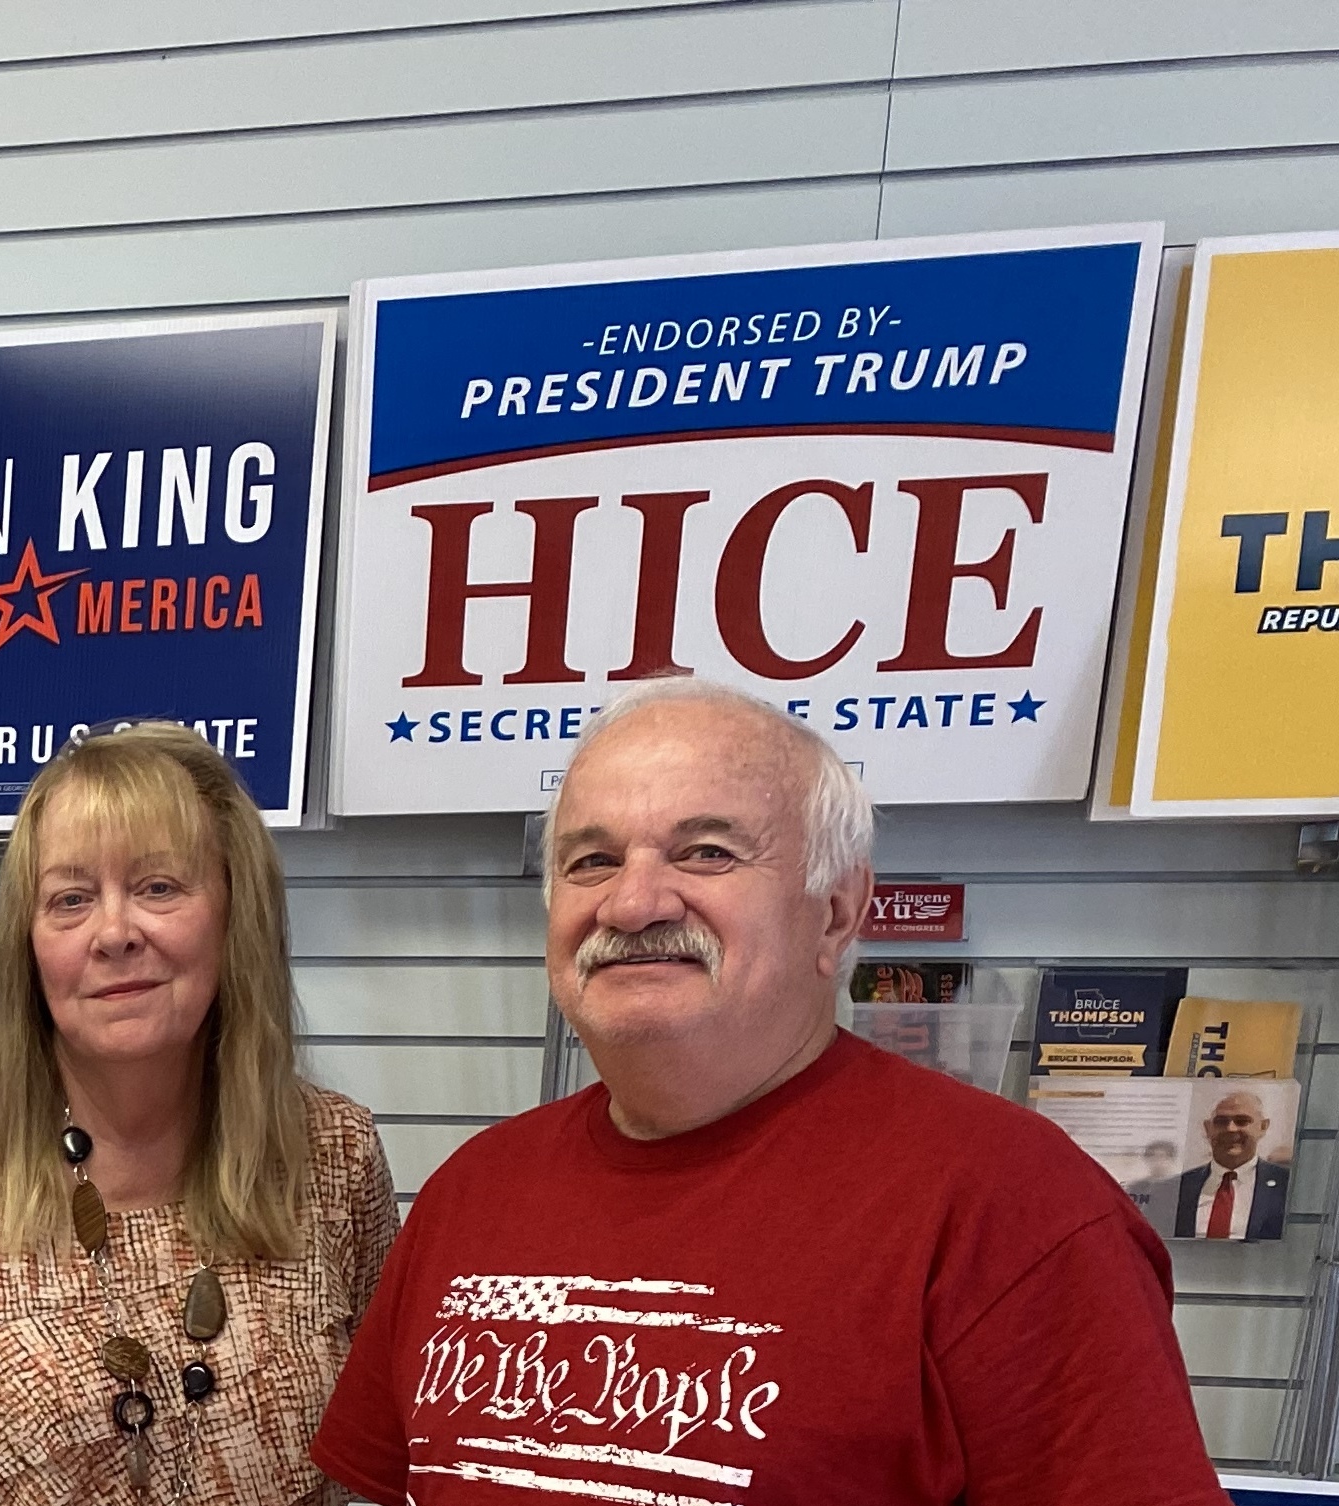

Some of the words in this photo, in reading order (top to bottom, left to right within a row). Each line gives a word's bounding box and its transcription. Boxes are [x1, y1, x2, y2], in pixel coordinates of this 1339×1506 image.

[461, 357, 791, 418] PRESIDENT
[814, 342, 1029, 397] TRUMP
[56, 441, 277, 553] KING
[401, 471, 1051, 688] HICE
[428, 705, 601, 744] SECRE
[833, 692, 998, 731] STATE
[872, 897, 911, 920] Yu
[893, 890, 952, 907] Eugene
[893, 924, 945, 932] CONGRESS
[1048, 1010, 1145, 1023] THOMPSON
[1074, 999, 1121, 1010] BRUCE
[412, 1325, 489, 1419] We
[553, 1334, 780, 1454] People
